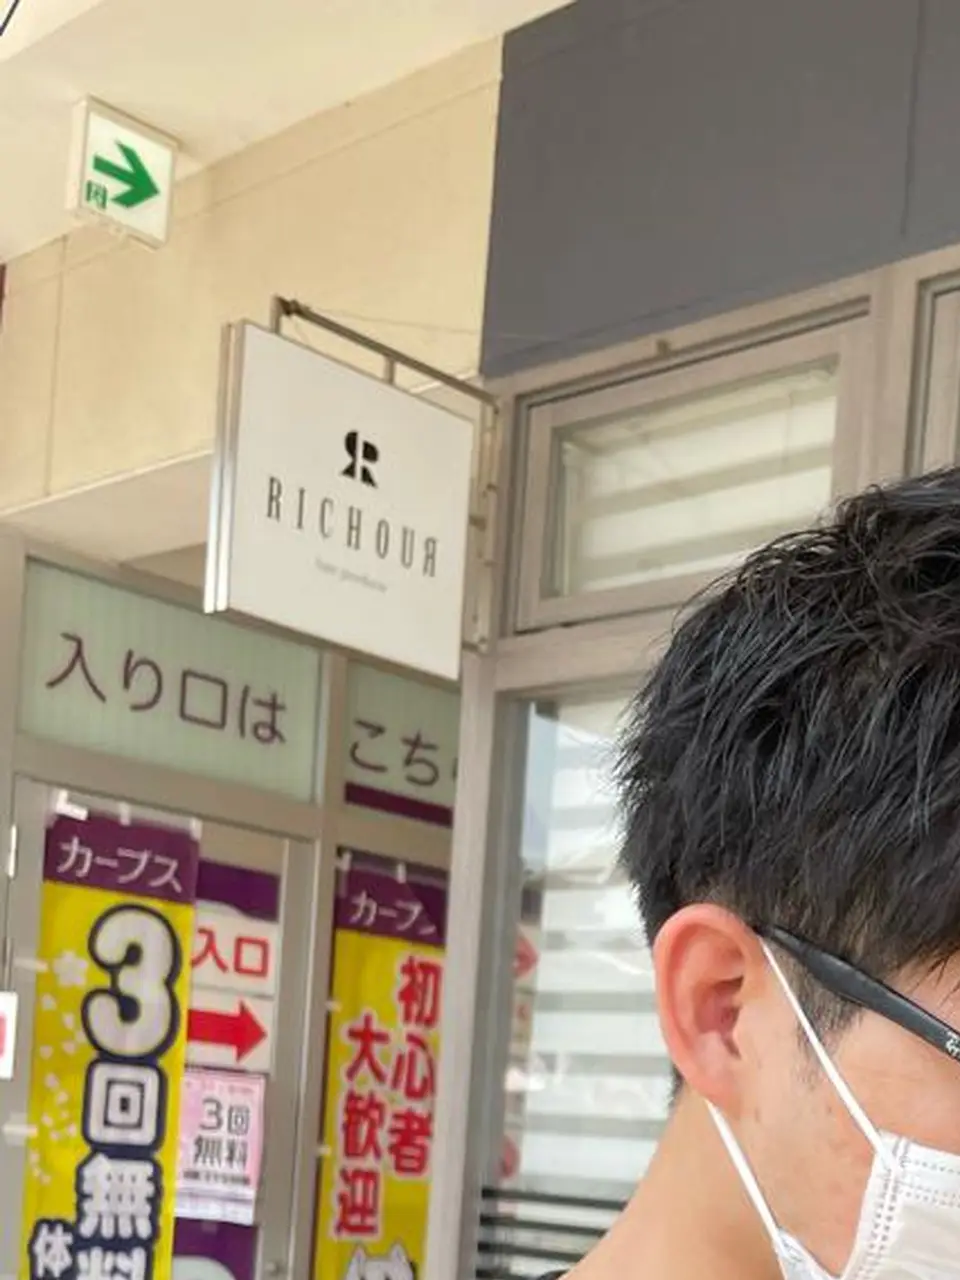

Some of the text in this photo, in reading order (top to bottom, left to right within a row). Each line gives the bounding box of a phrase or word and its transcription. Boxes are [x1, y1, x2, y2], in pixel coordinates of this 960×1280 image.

[45, 631, 287, 746] 入り口は
[349, 717, 458, 788] こち
[189, 926, 270, 978] 入口
[390, 955, 443, 1178] 初心者
[334, 1013, 391, 1236] 大歓迎
